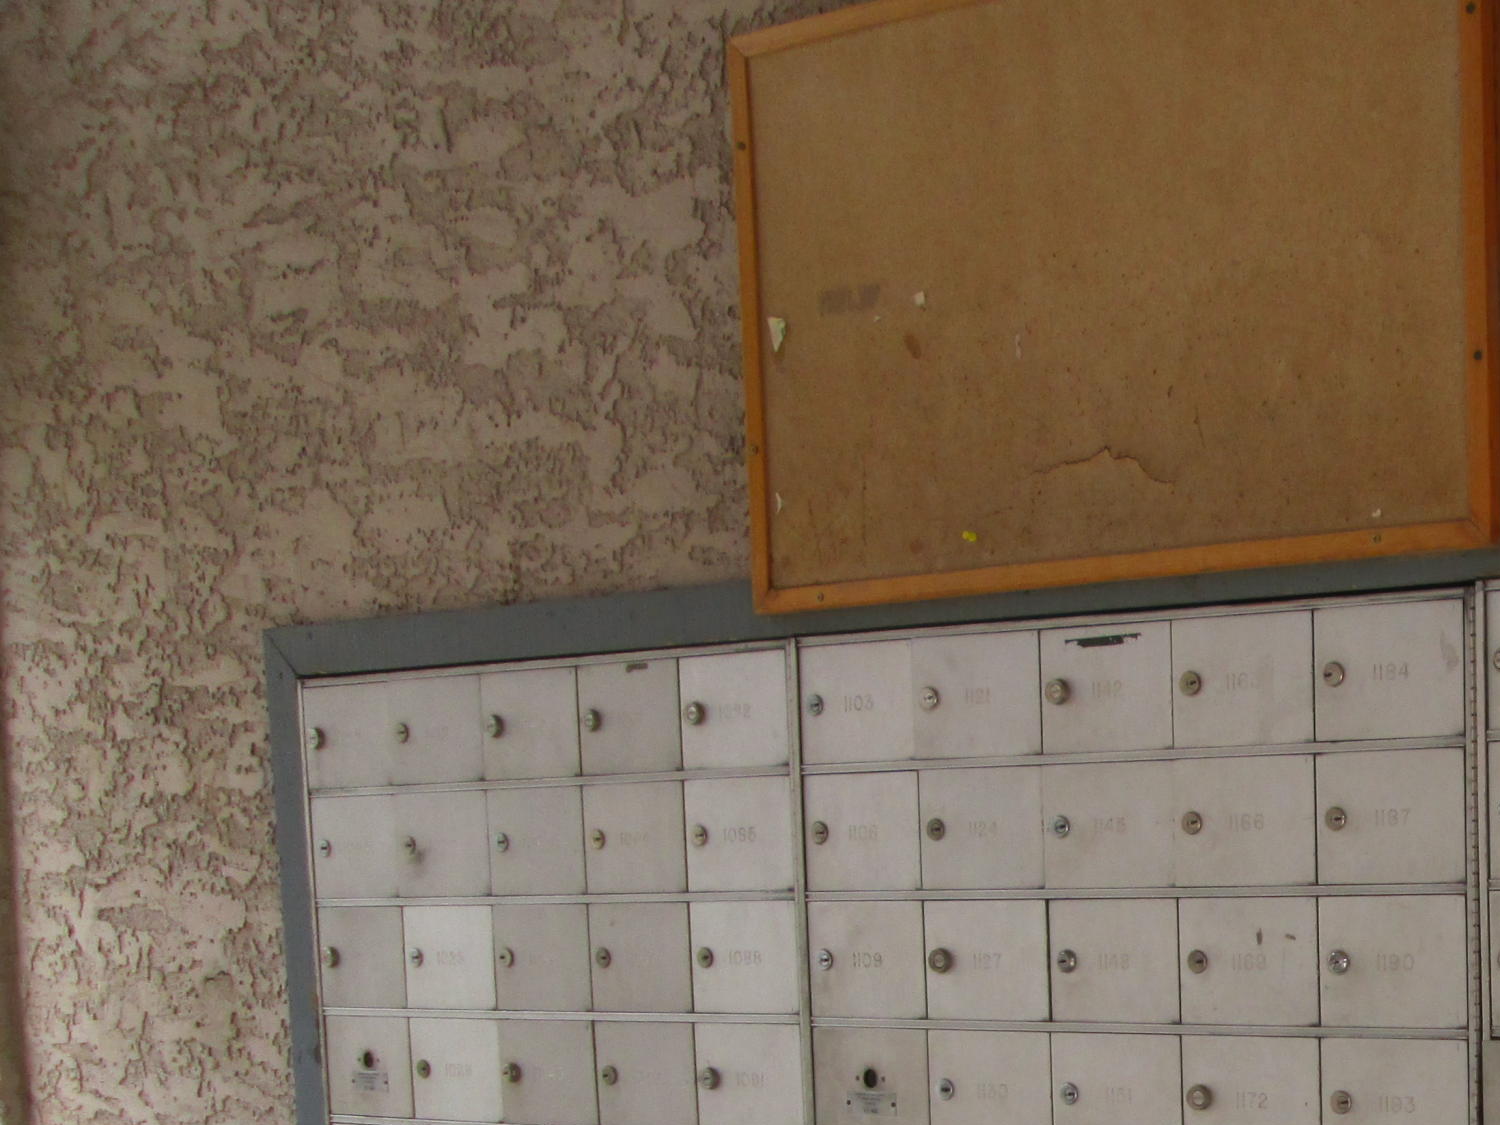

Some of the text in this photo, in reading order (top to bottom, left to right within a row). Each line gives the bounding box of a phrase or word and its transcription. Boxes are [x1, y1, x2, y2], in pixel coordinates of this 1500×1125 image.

[1373, 663, 1409, 681] 1184
[844, 694, 874, 712] 1103
[853, 952, 883, 969] 1109
[1237, 1091, 1267, 1110] 1172
